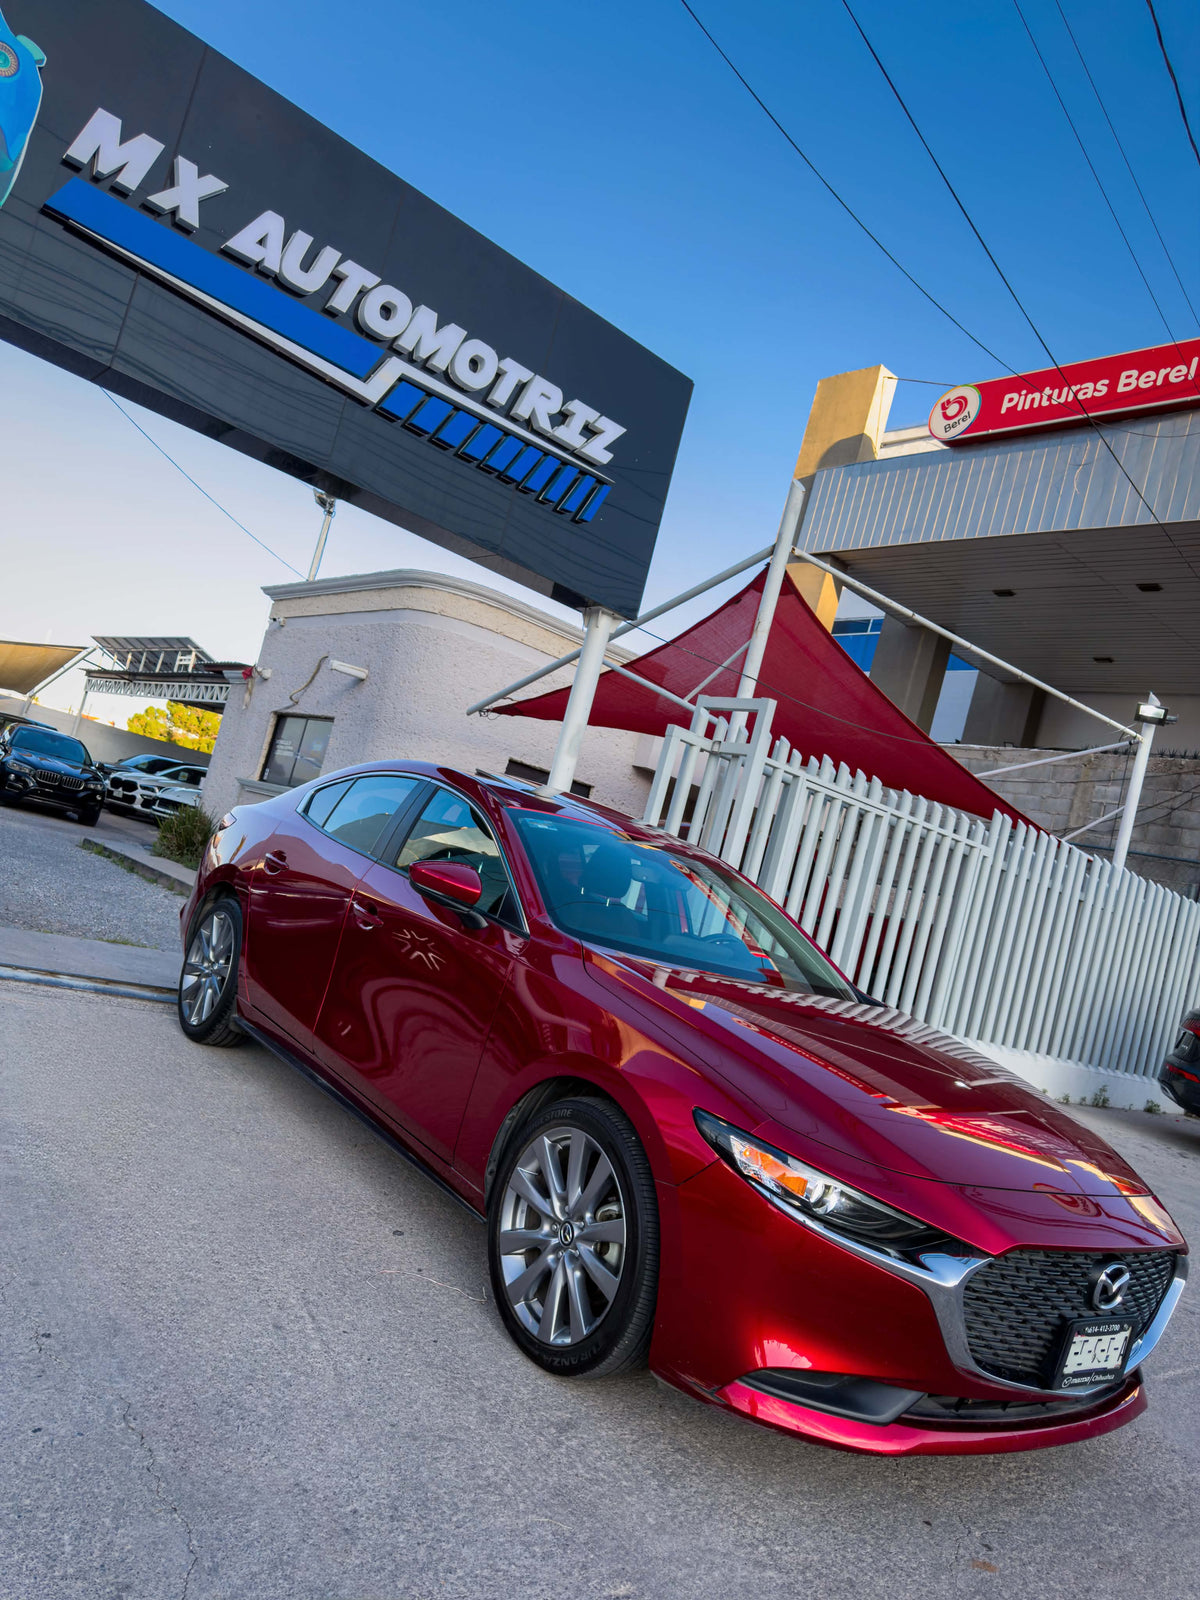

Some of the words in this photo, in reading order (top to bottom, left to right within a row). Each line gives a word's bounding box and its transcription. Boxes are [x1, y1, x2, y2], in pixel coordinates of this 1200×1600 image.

[63, 107, 229, 231] MX
[221, 210, 626, 464] AUTOMOTRIZ
[1000, 380, 1109, 414] Pinturas
[1116, 356, 1199, 393] Berel
[943, 411, 971, 433] Berel
